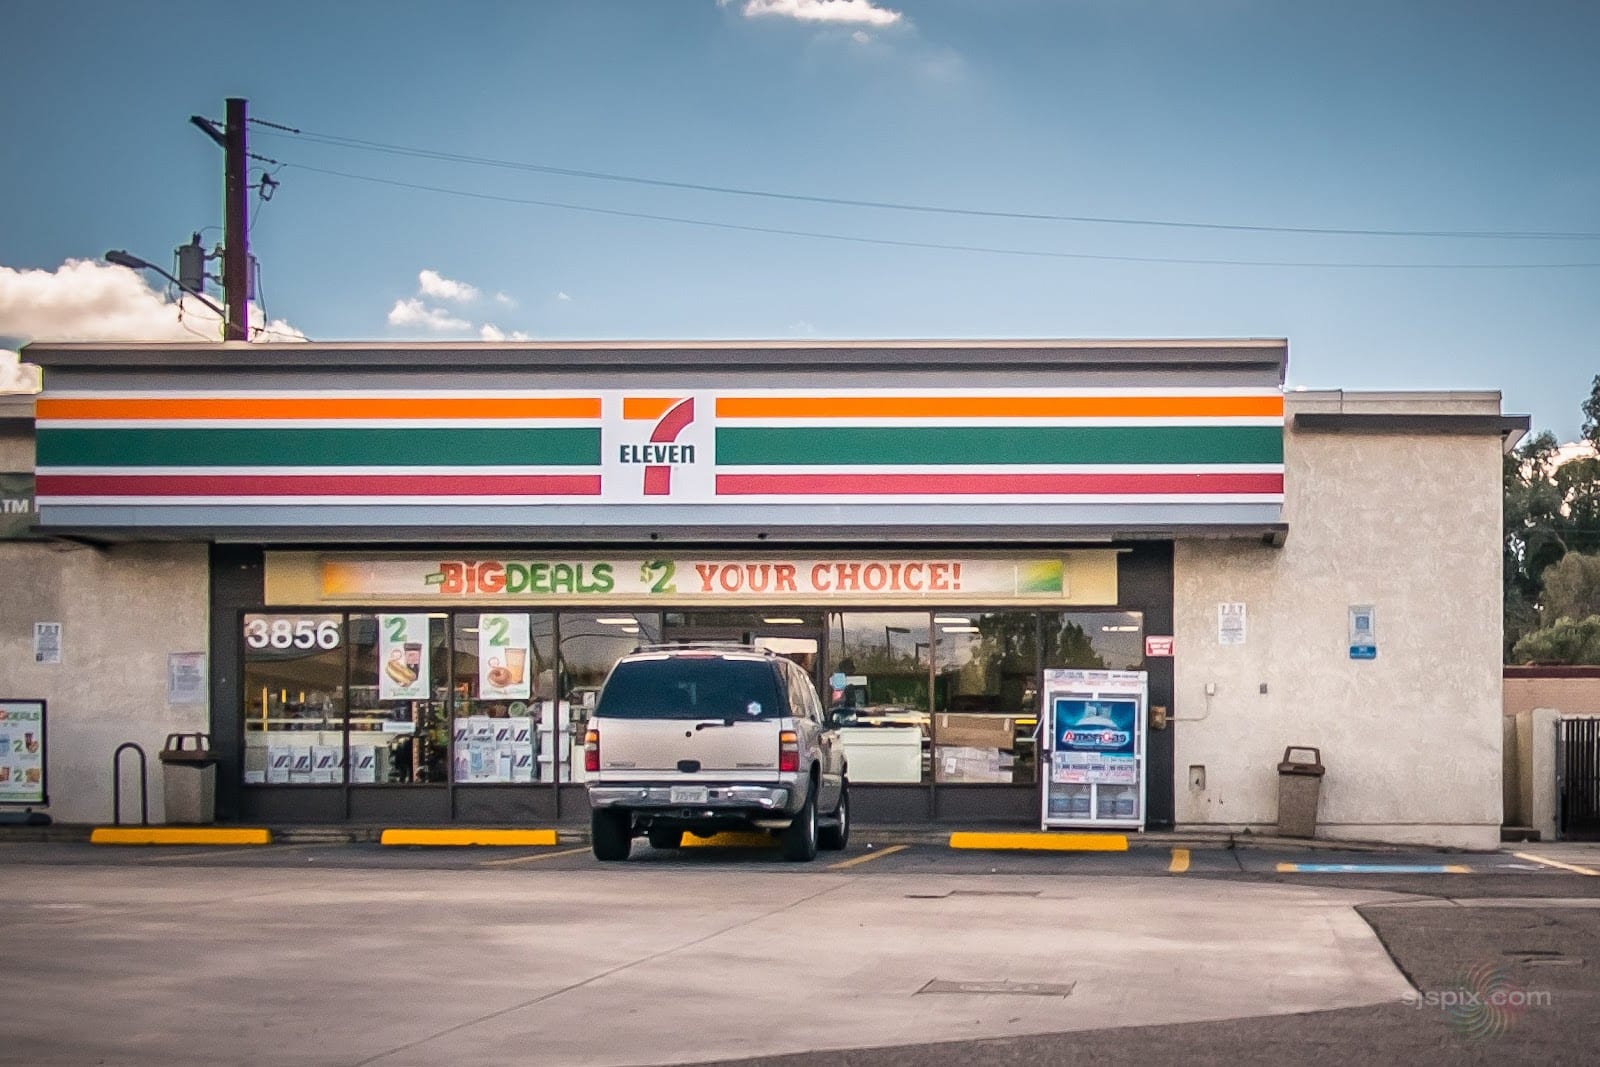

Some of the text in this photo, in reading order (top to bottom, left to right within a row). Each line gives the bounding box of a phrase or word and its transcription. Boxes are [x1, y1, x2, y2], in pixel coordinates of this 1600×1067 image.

[0, 499, 29, 513] TM
[641, 559, 677, 593] $2
[695, 564, 797, 591] YOUR
[811, 563, 961, 591] CHOICE!
[247, 619, 340, 649] 3856
